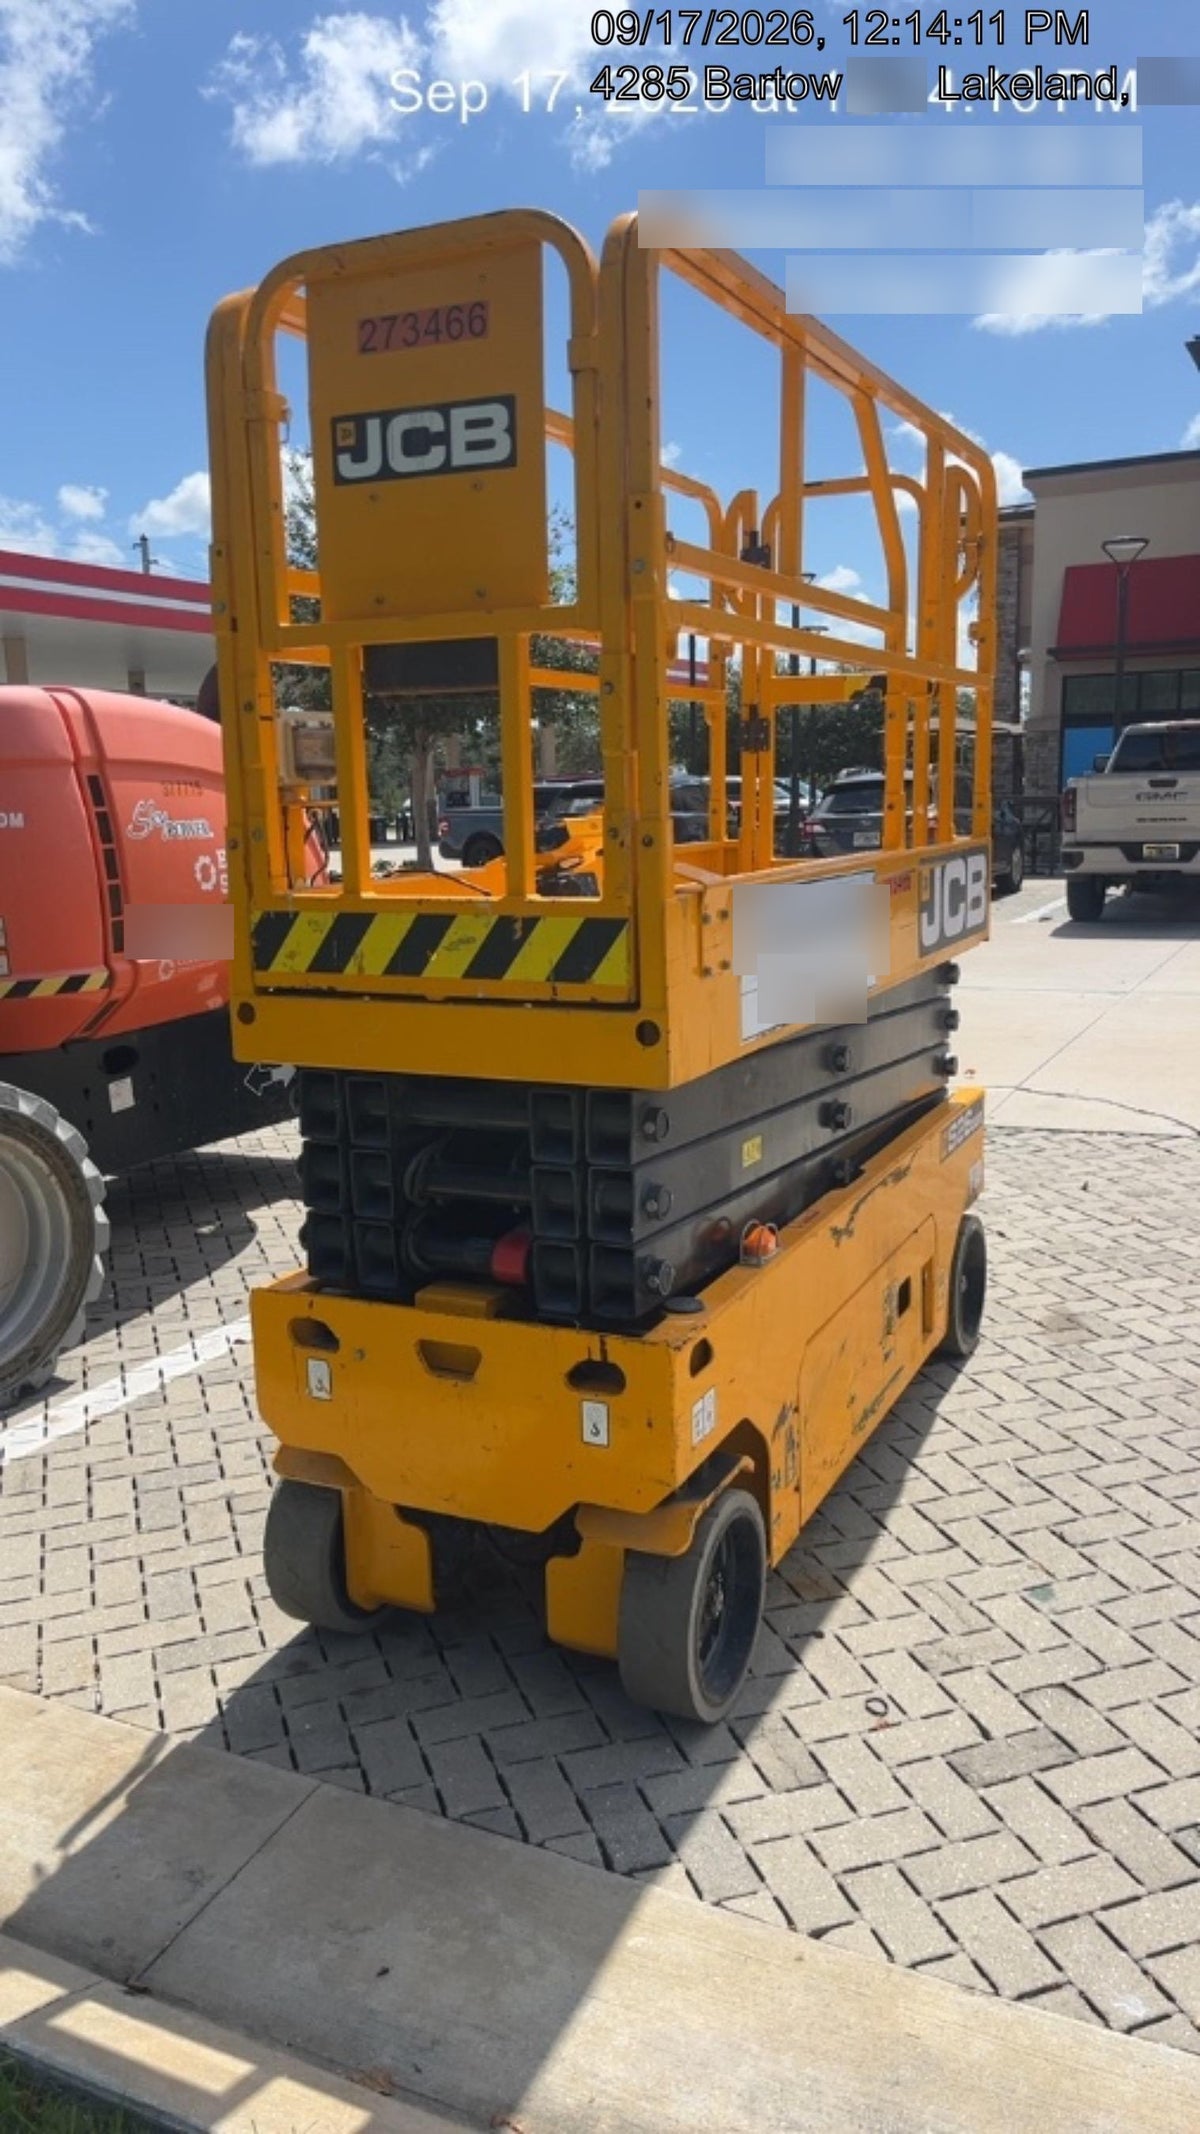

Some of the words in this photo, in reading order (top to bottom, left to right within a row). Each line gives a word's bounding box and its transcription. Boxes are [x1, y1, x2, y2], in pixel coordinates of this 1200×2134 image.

[359, 302, 487, 354] 273466
[336, 403, 512, 480] JCB
[921, 853, 988, 947] JCB
